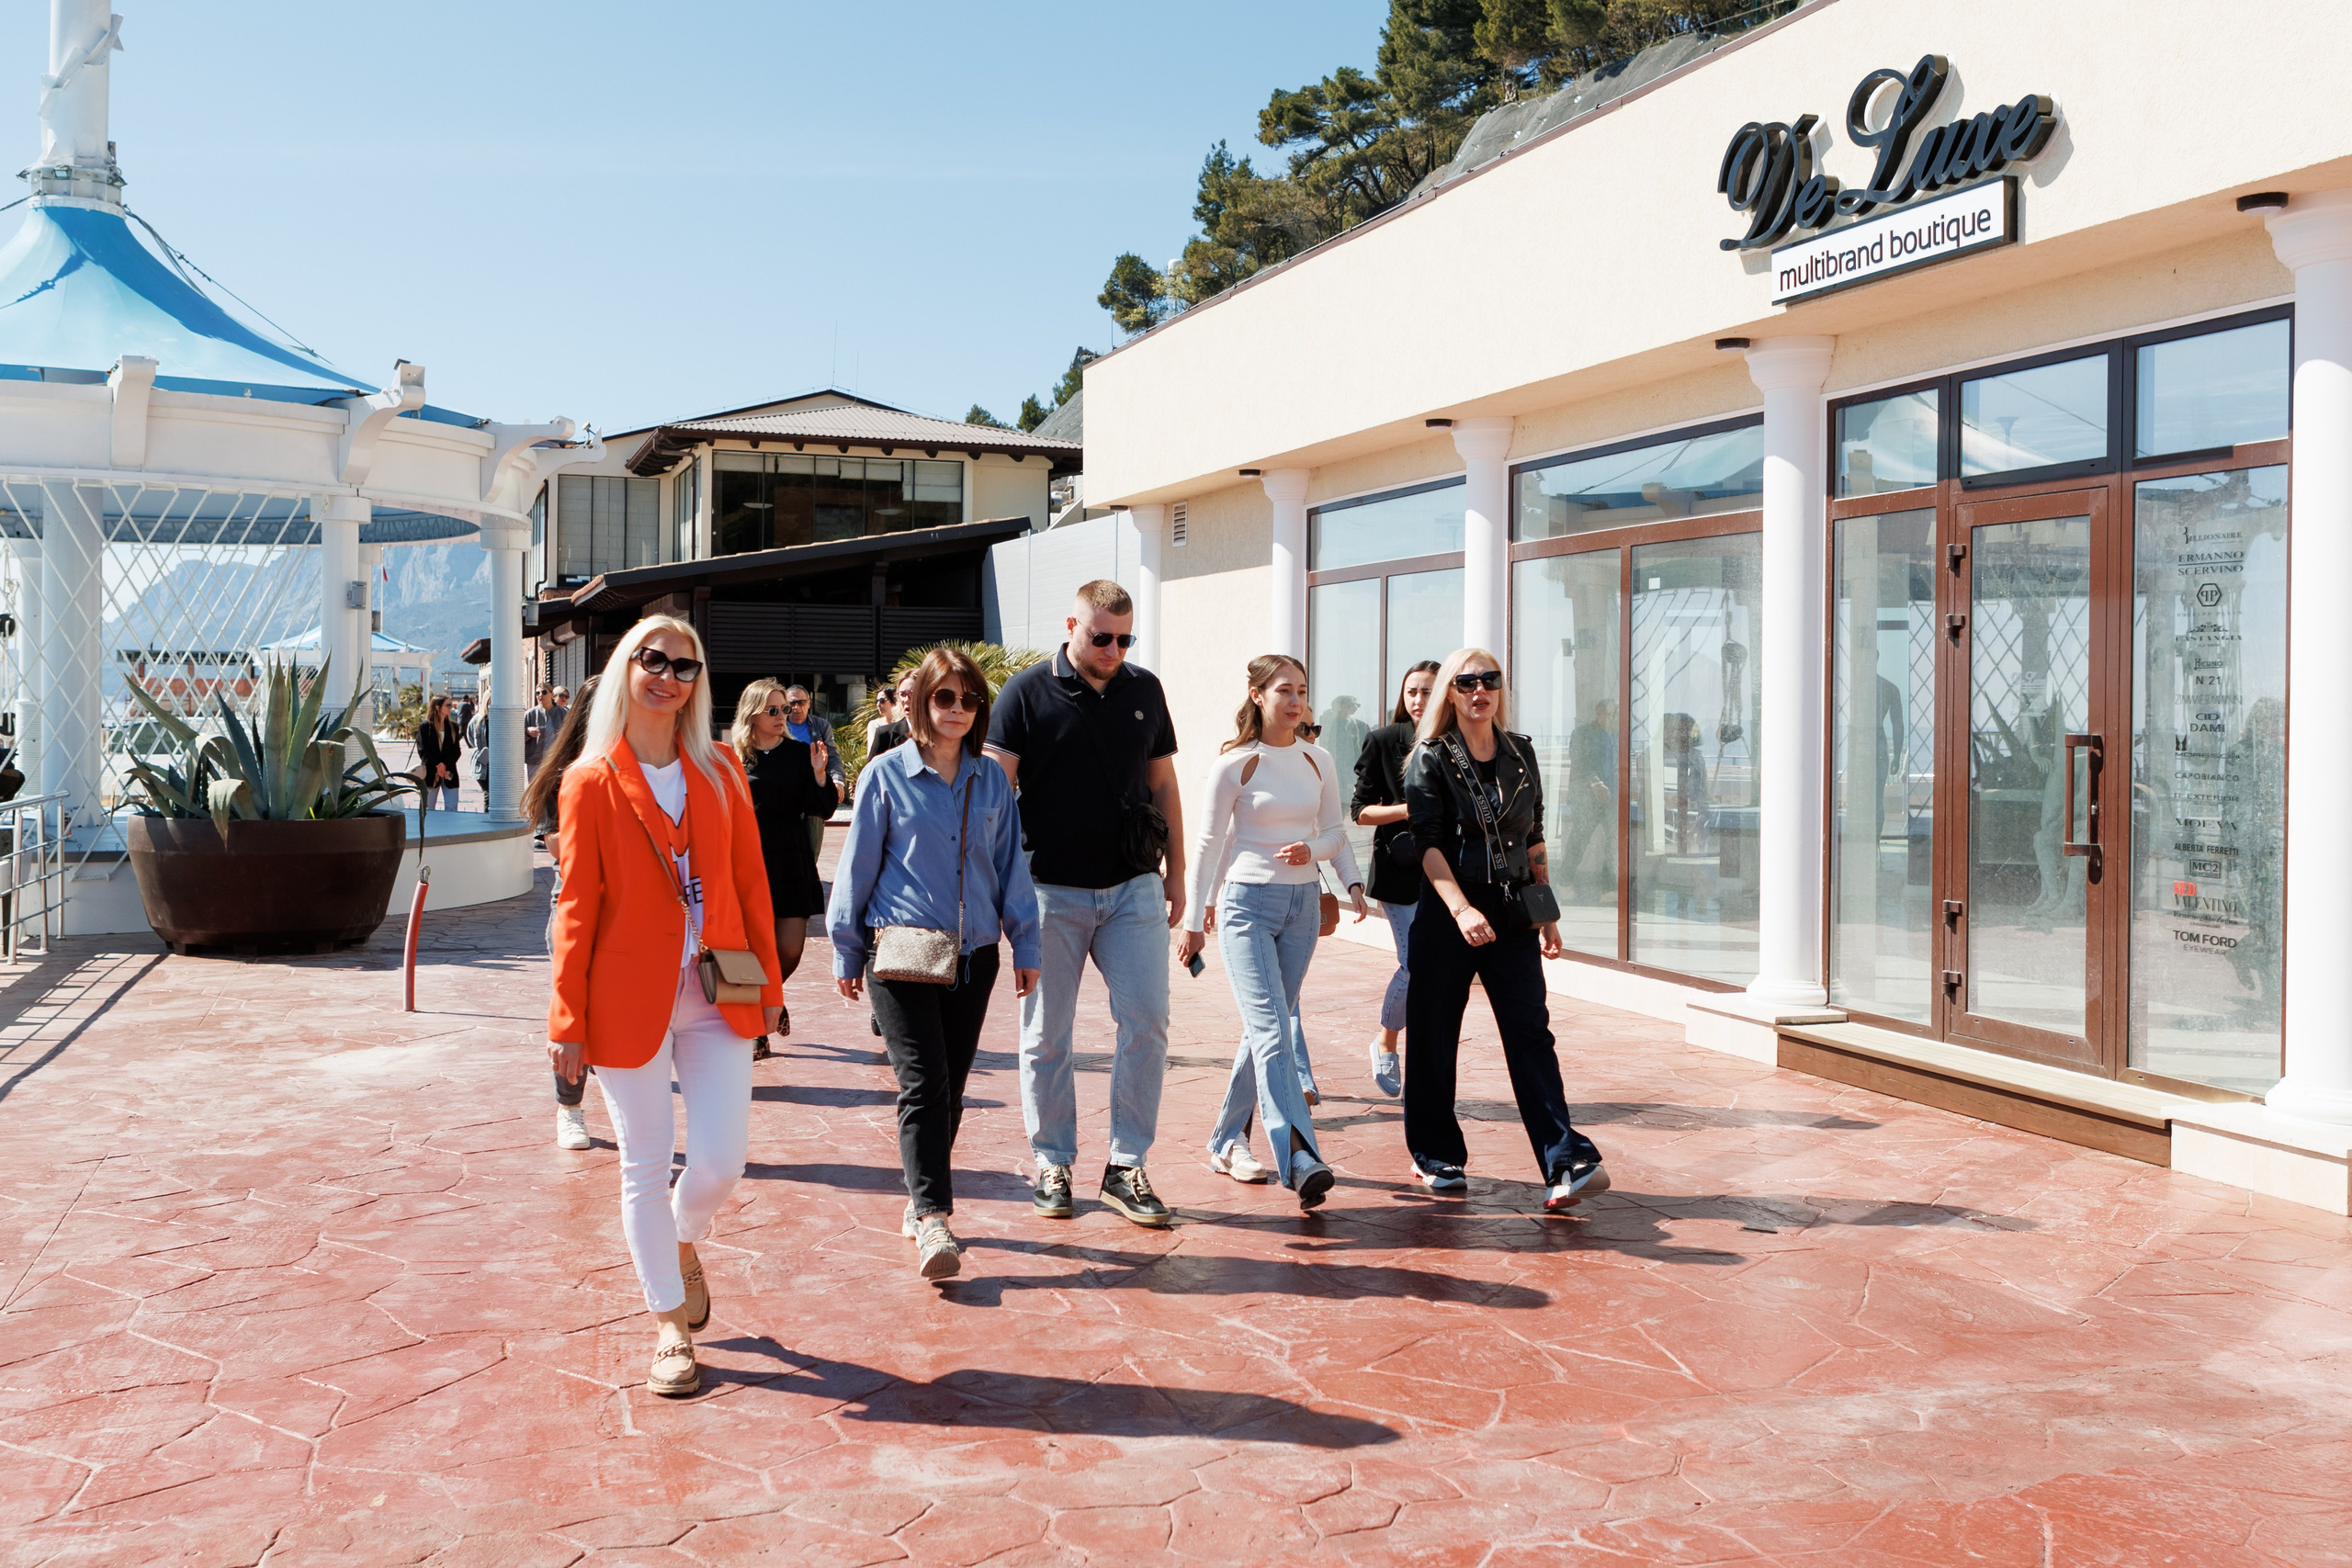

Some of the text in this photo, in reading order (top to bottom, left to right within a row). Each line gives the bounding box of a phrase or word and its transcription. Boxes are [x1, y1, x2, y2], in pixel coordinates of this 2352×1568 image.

[1780, 208, 1991, 292] multibrand boutique
[2178, 551, 2244, 562] ERMANNO
[2177, 564, 2244, 576] SCERVINO
[2189, 723, 2225, 733] DAMI
[1450, 743, 1469, 770] GUESS
[2174, 772, 2240, 782] CAPOBIANCO
[1476, 795, 1493, 823] GUESS
[2174, 842, 2239, 856] ALBERTA FERRETTI
[2174, 880, 2197, 897] RED
[2174, 893, 2237, 913] VALENTINO
[2173, 930, 2237, 948] TOM FORD
[2183, 944, 2226, 955] EYEWEAR
